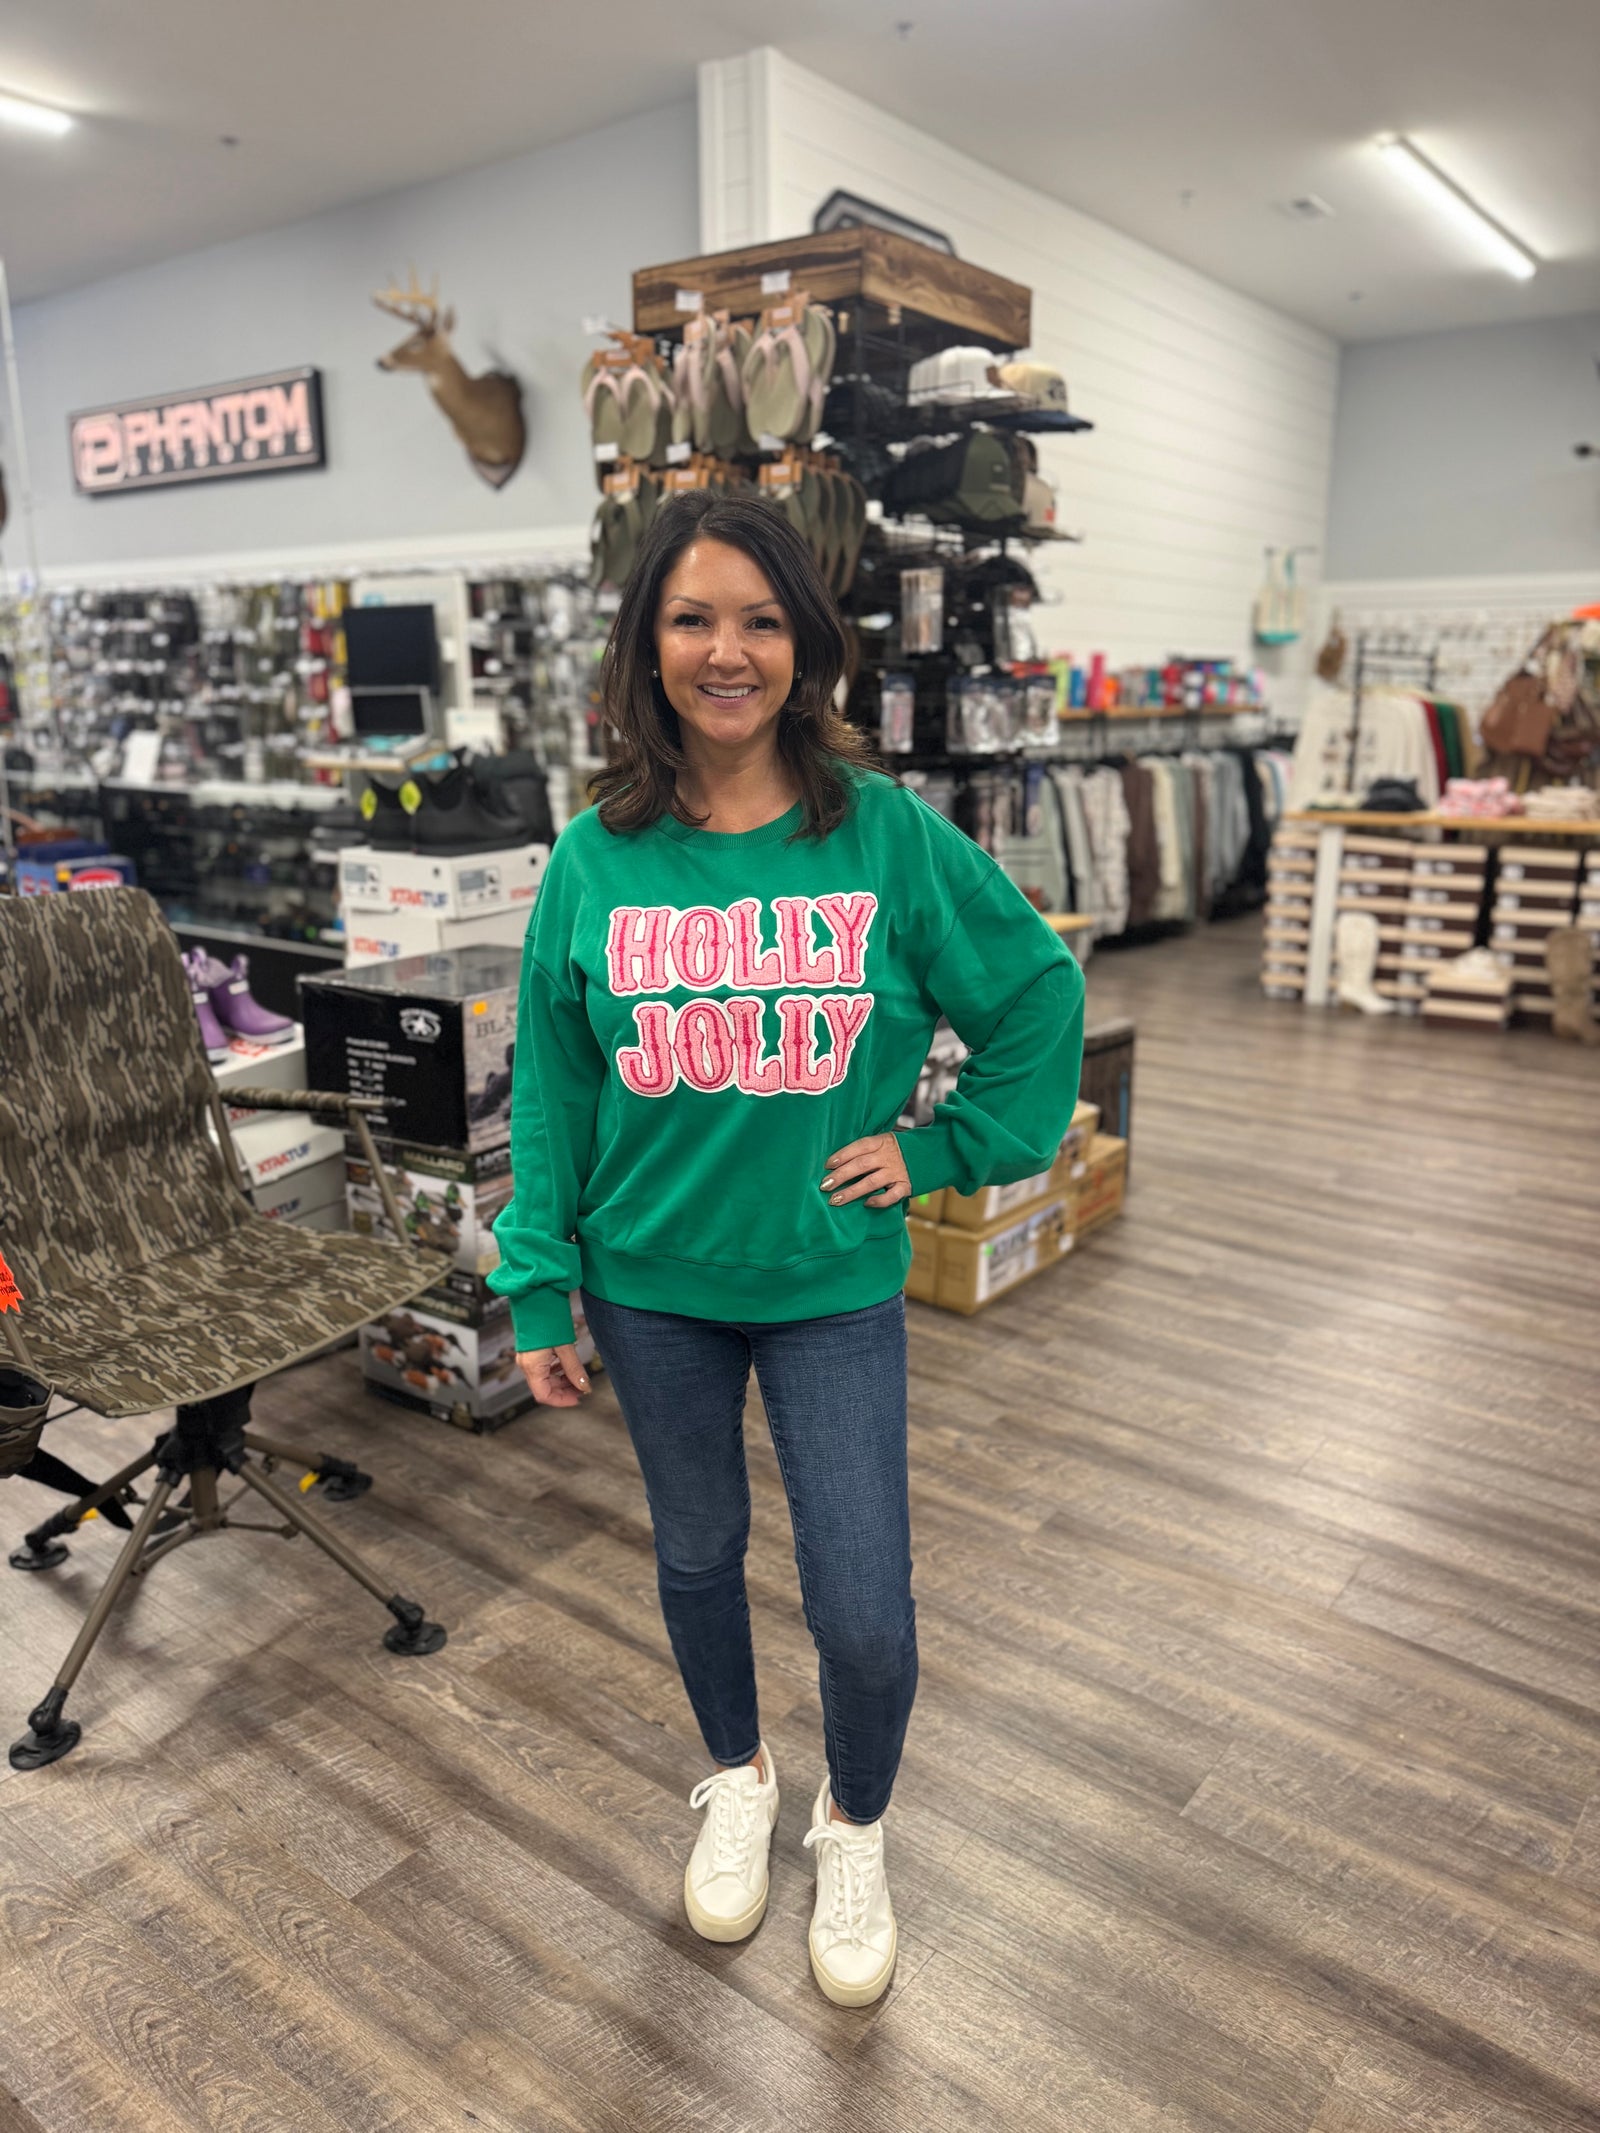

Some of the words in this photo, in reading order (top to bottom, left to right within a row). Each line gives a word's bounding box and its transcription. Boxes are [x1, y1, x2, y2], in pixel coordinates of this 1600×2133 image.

[122, 381, 310, 457] PHANTOM
[389, 887, 447, 907] XTRATUF
[607, 893, 877, 995] HOLLY
[617, 994, 873, 1096] JOLLY
[256, 1143, 310, 1175] XTRATUF
